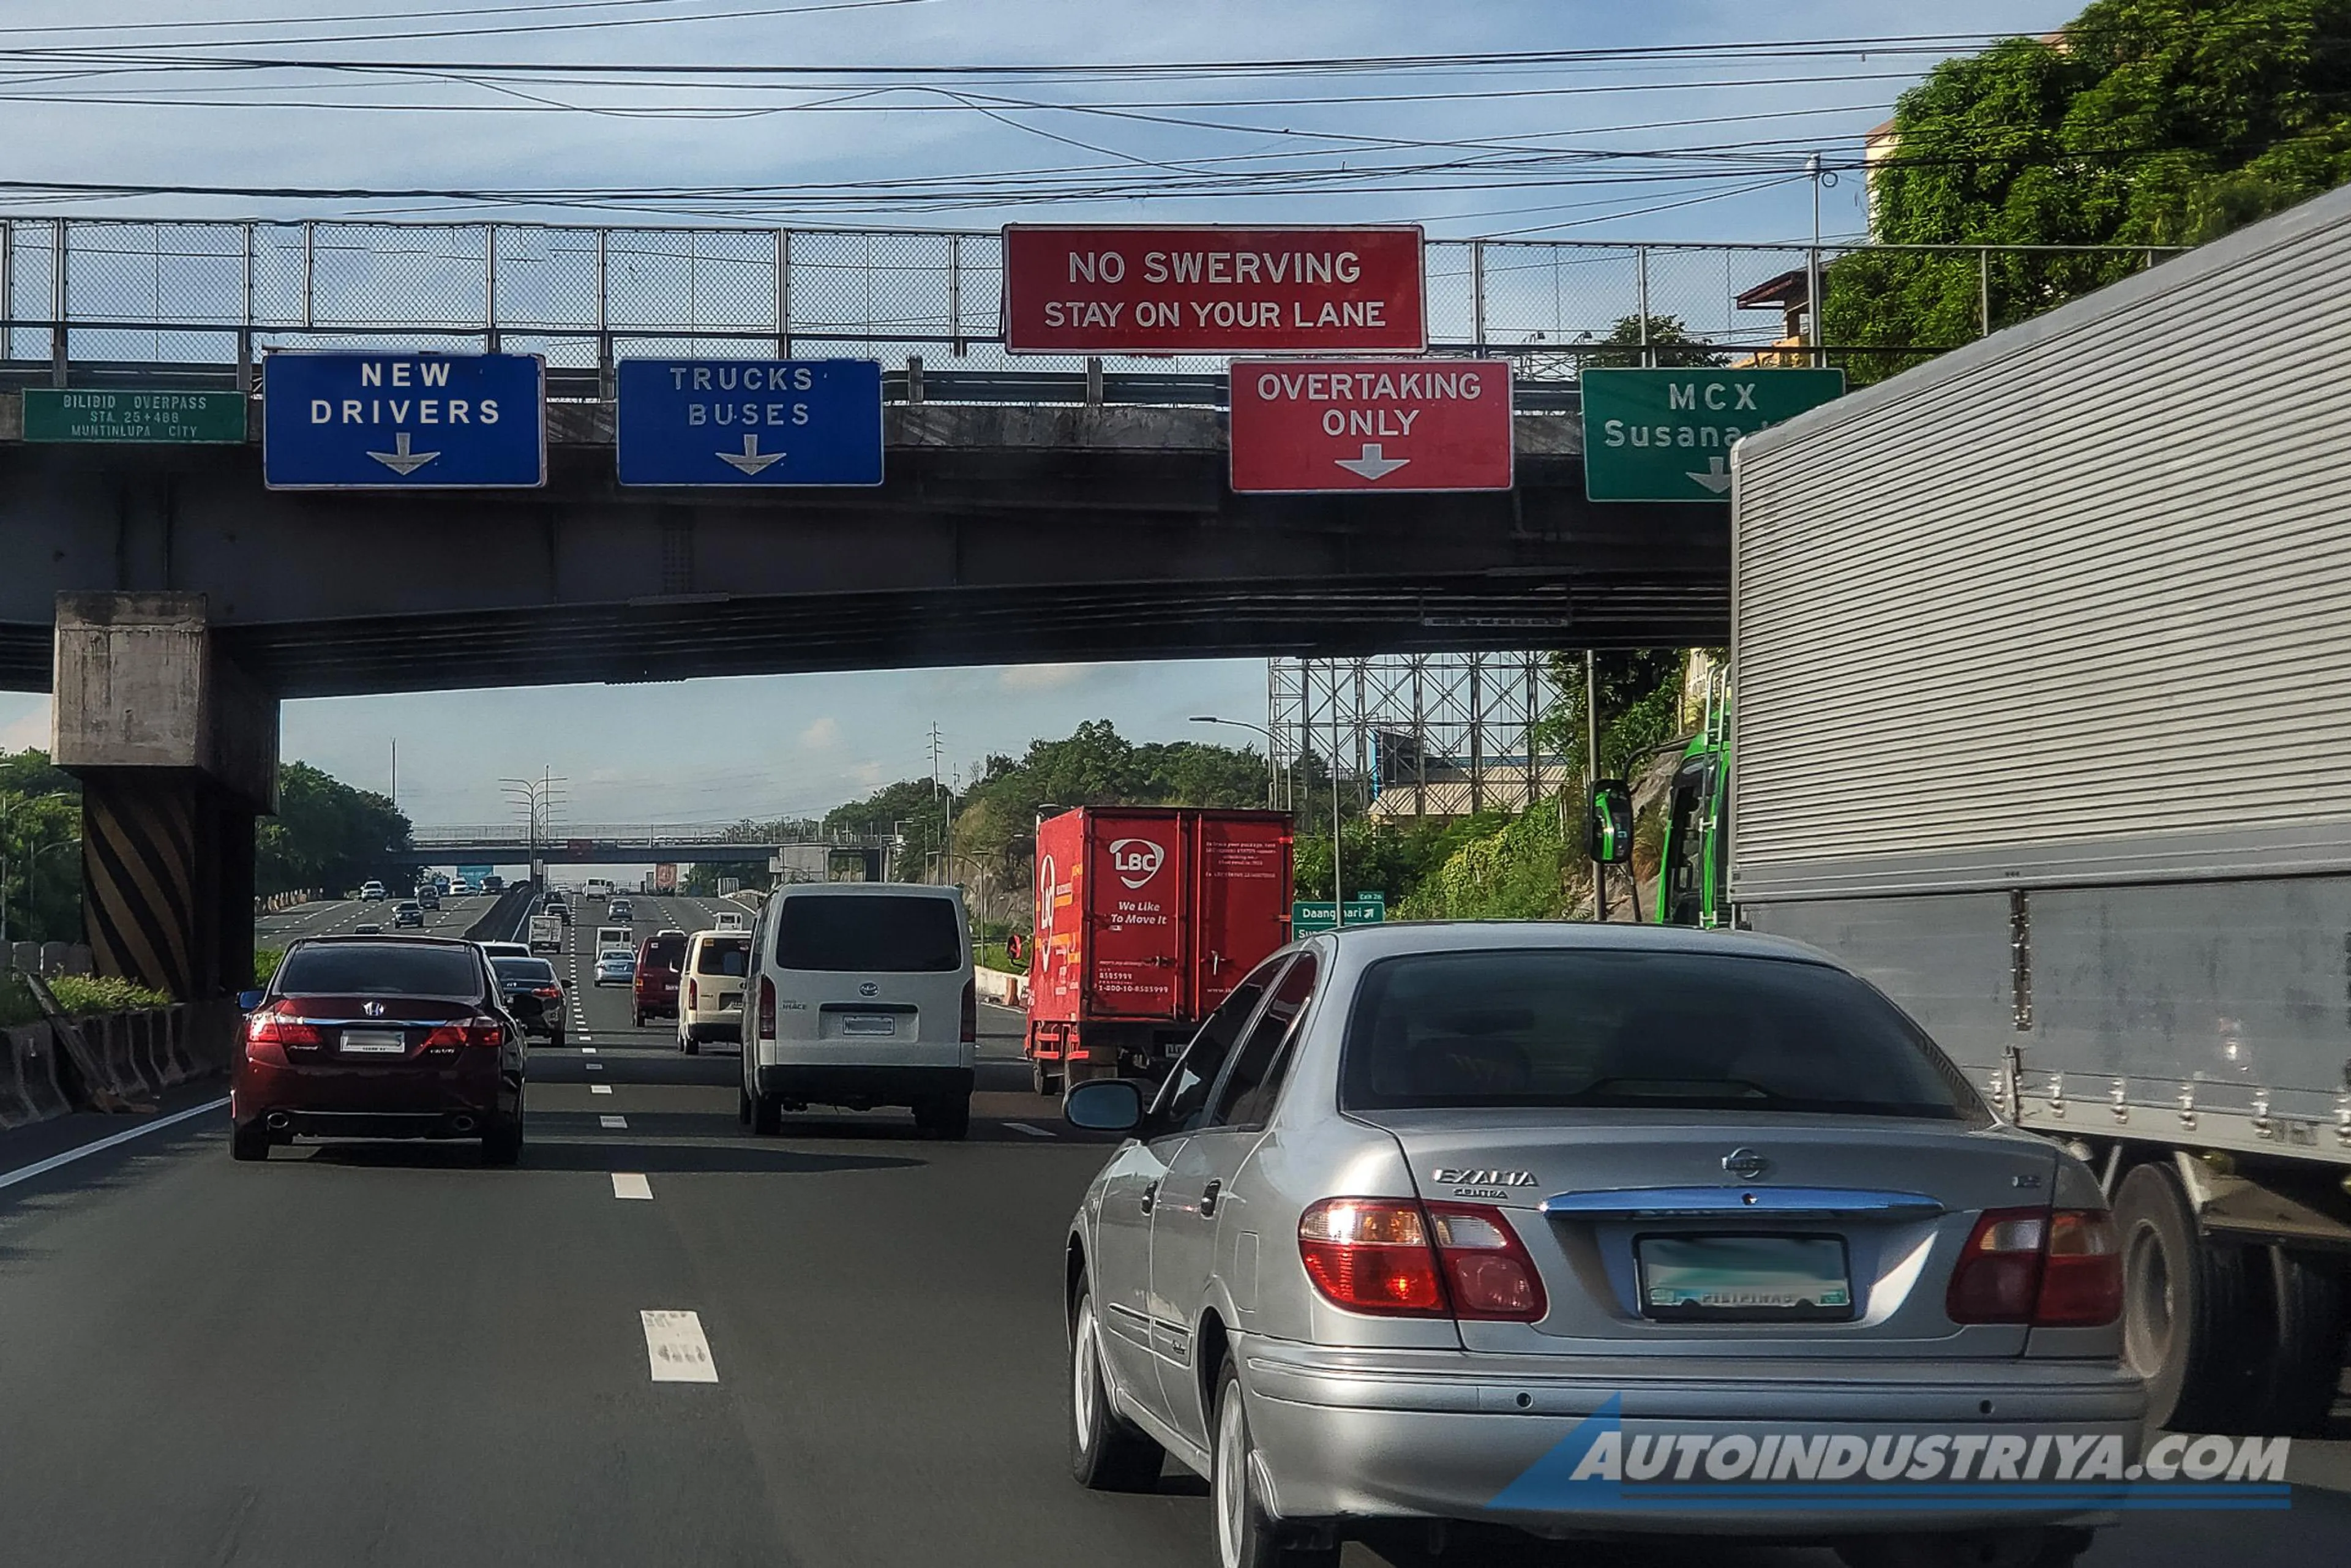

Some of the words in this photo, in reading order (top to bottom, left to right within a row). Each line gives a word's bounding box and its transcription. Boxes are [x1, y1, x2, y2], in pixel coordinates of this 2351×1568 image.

[1068, 251, 1125, 283] NO
[1144, 252, 1361, 283] SWERVING
[1045, 302, 1124, 328] STAY
[1136, 302, 1179, 327] ON
[1191, 302, 1280, 328] YOUR
[1294, 302, 1386, 328] LANE
[361, 362, 450, 386] NEW
[670, 368, 812, 390] TRUCKS
[1258, 373, 1482, 400] OVERTAKING
[1669, 383, 1757, 410] MCX
[64, 396, 116, 408] BILIBID
[134, 396, 207, 409] OVERPASS
[312, 399, 500, 424] DRIVERS
[689, 404, 809, 426] BUSES
[1322, 410, 1420, 436] ONLY
[72, 425, 151, 437] MUNTINLUPA
[169, 426, 197, 437] CITY
[1116, 852, 1157, 871] LBC
[1119, 901, 1134, 910] We
[1138, 901, 1160, 911] Like
[1302, 909, 1335, 920] Daang
[1111, 914, 1123, 923] To
[1125, 914, 1155, 924] Move
[1158, 915, 1167, 924] It
[1433, 1169, 1539, 1186] EXALTA
